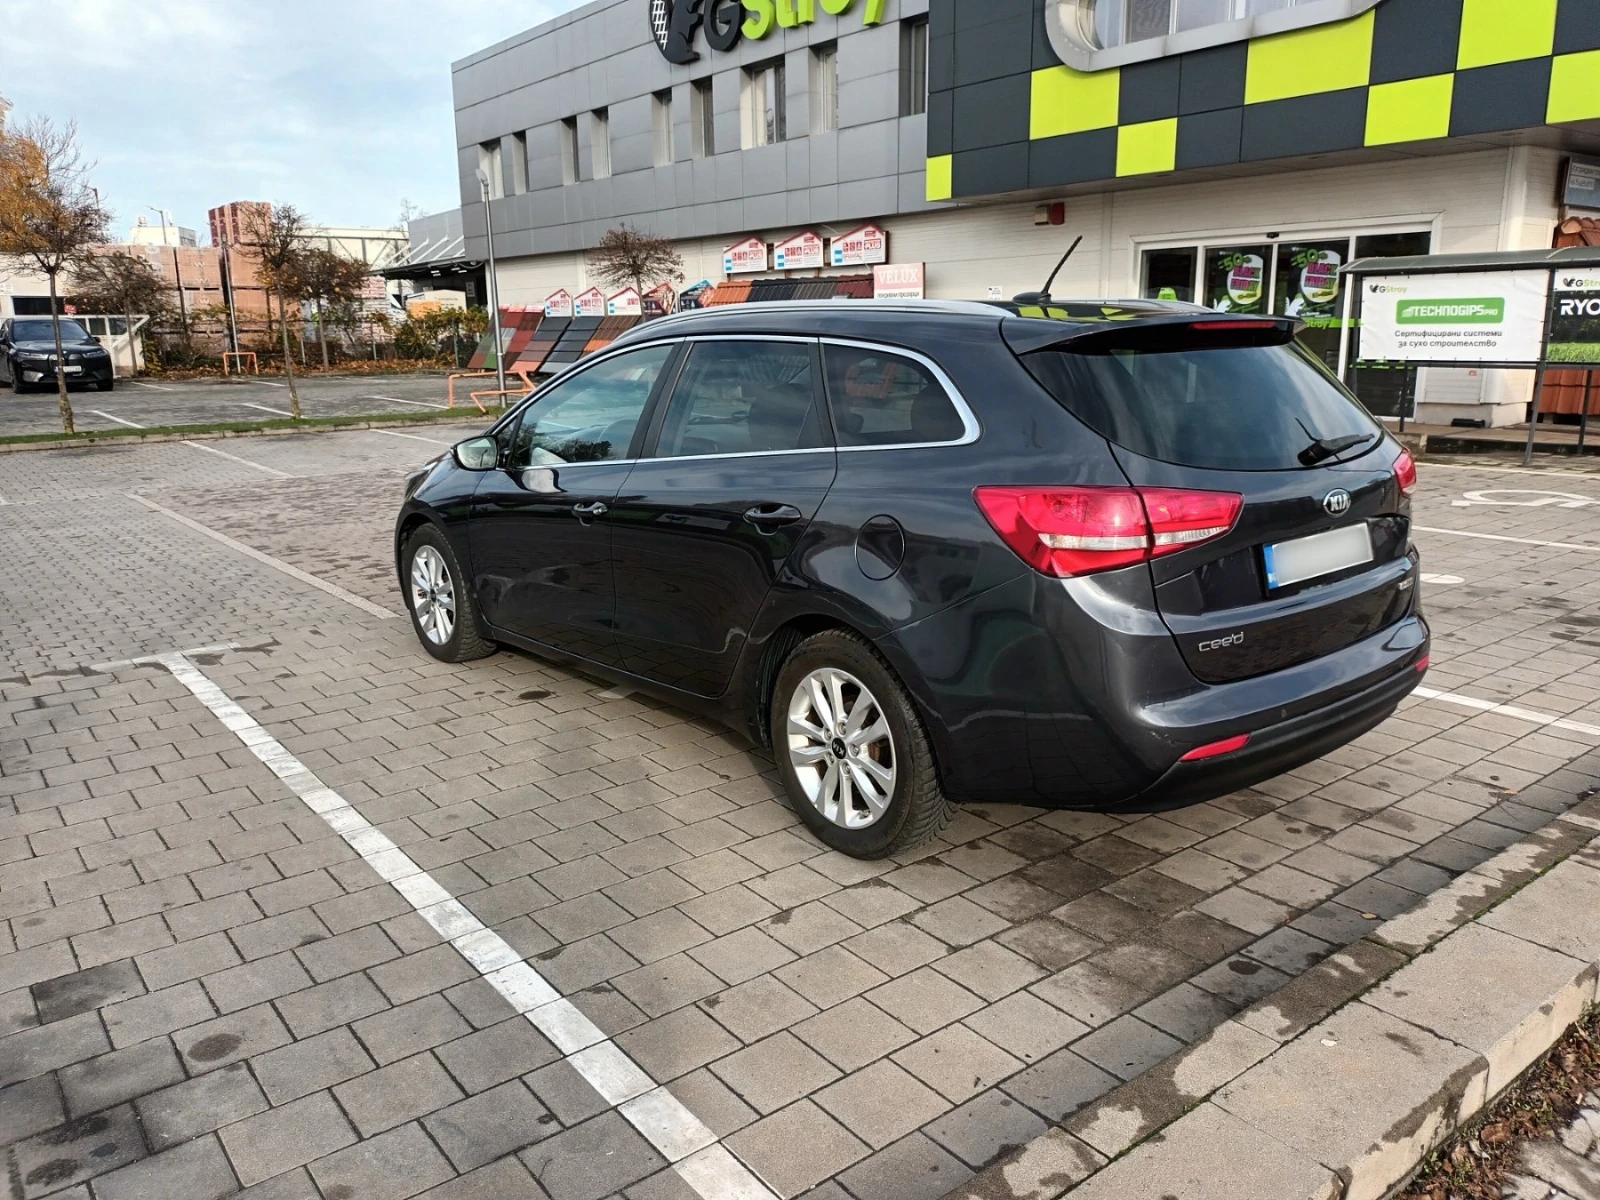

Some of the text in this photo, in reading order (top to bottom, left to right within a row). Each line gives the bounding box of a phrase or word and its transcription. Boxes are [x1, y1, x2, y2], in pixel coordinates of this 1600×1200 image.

[878, 269, 918, 284] VELUX
[1379, 285, 1407, 294] GStroy
[1560, 298, 1600, 316] RYO
[1394, 330, 1462, 338] Сертифицирани
[1398, 339, 1497, 348] за сухо строителство
[1329, 493, 1350, 512] KIA
